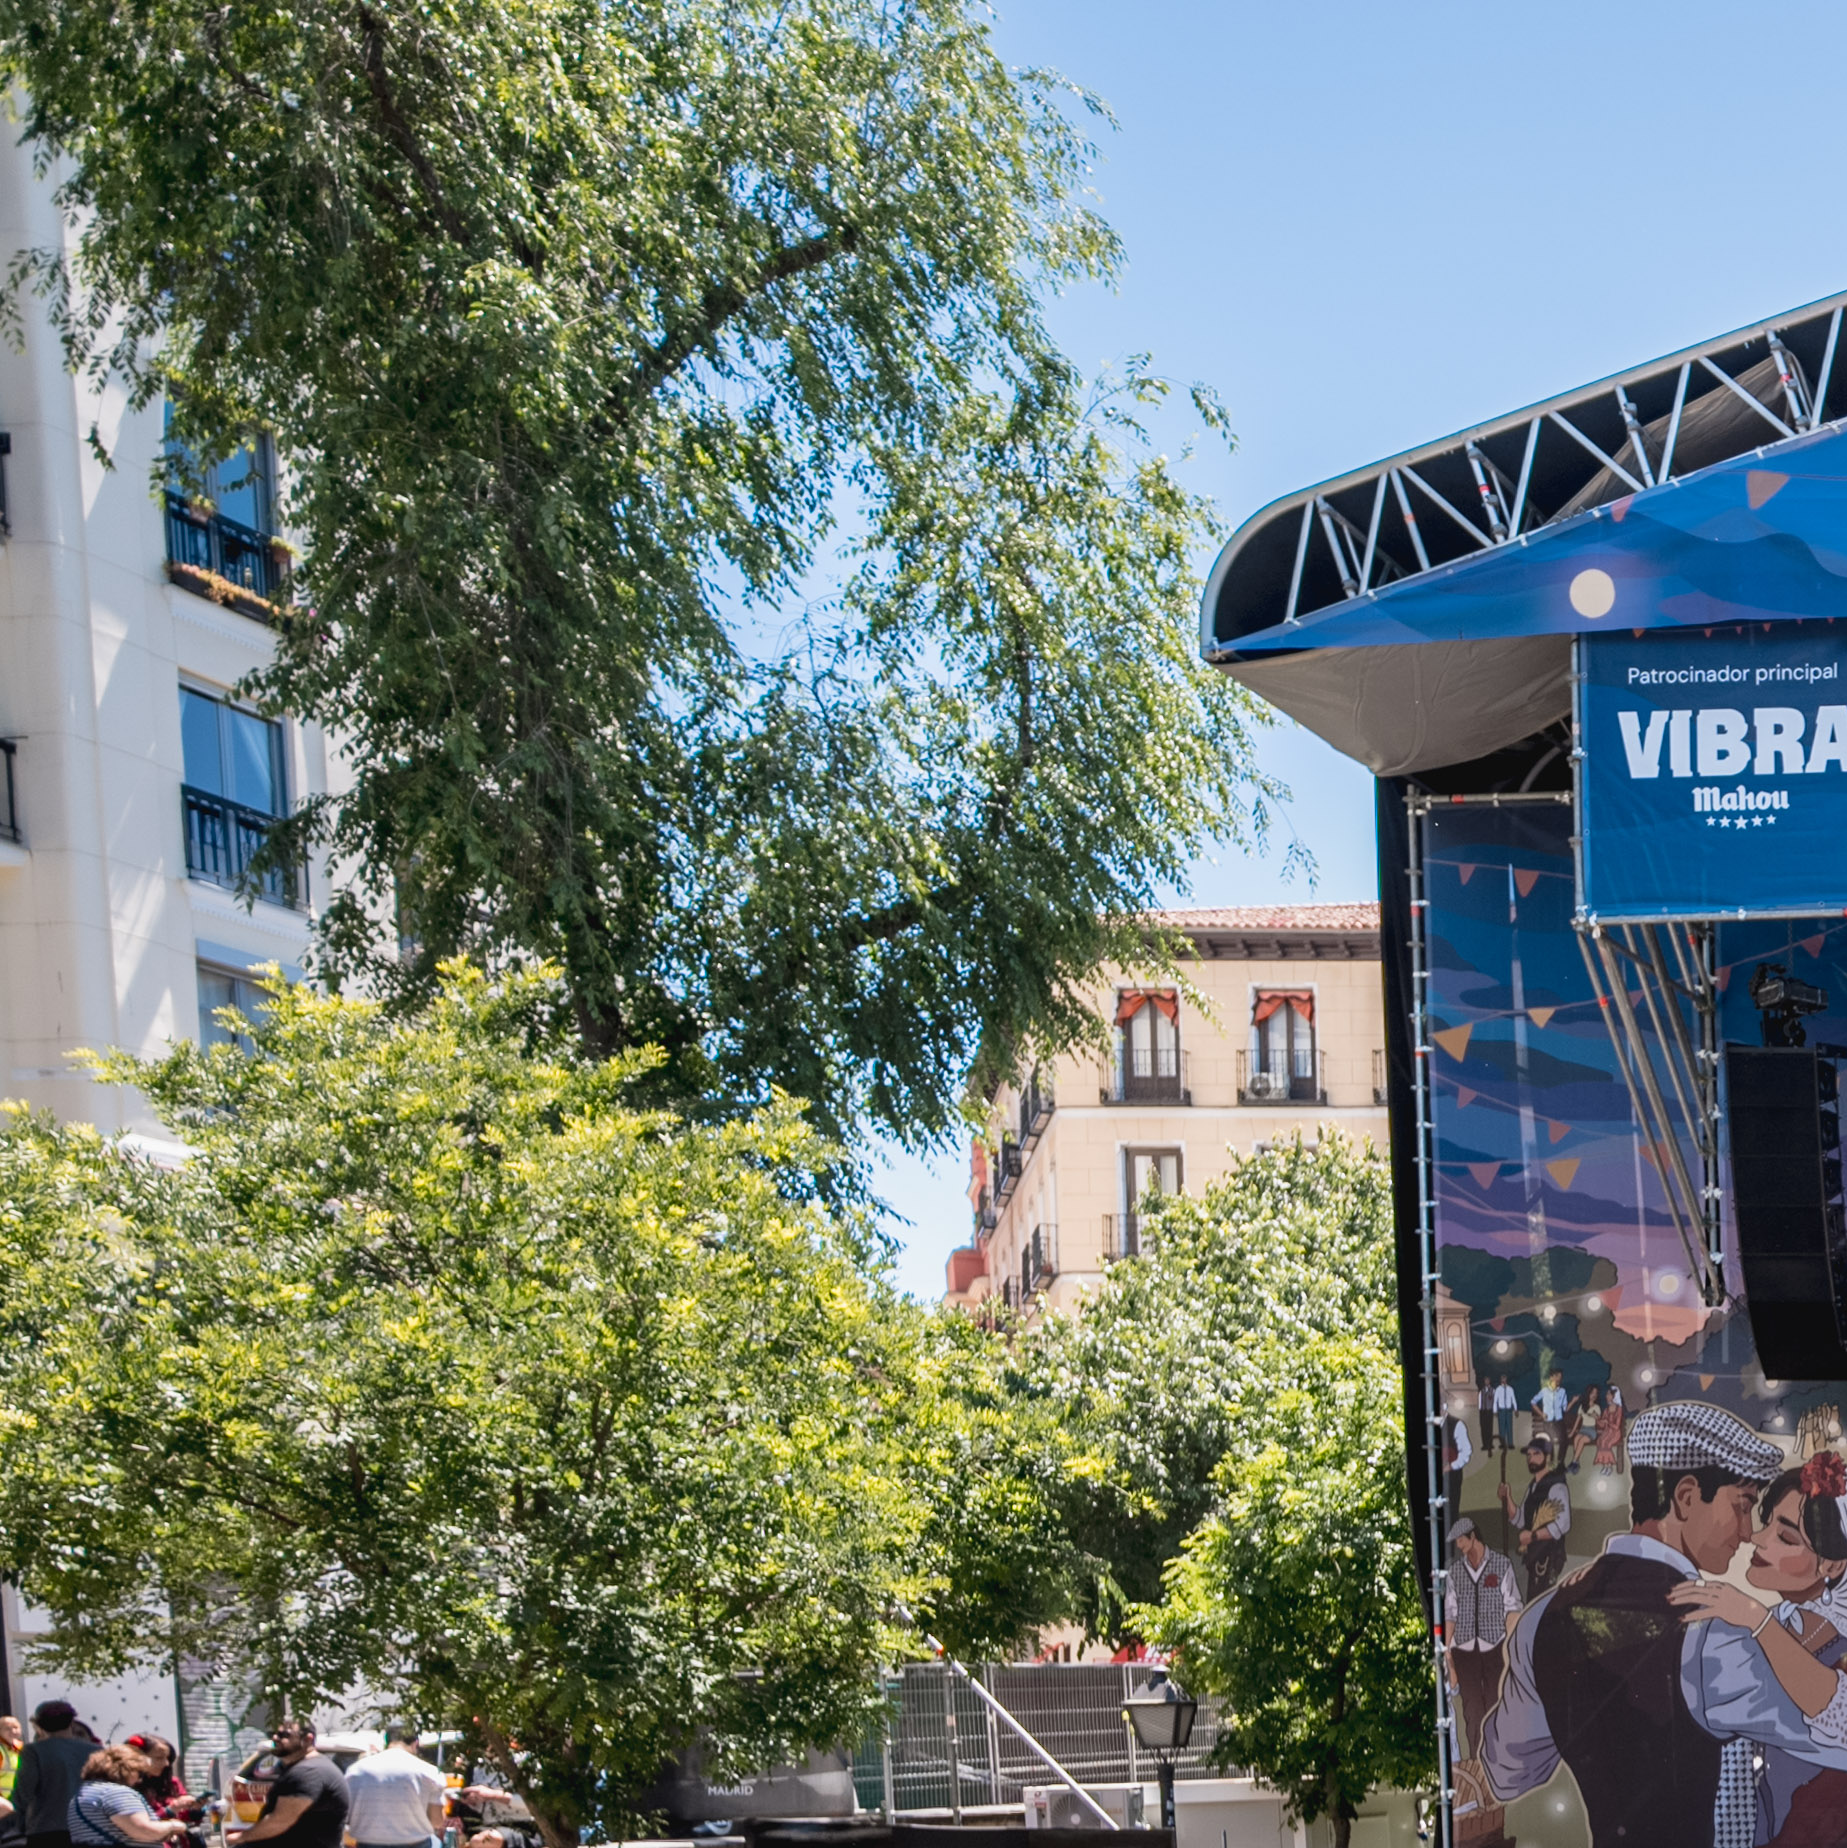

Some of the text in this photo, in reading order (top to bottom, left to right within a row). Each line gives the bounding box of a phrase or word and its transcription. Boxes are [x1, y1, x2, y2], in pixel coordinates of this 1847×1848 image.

[1628, 662, 1837, 686] Patrocinador principal
[1692, 785, 1790, 812] Mahou
[707, 1786, 754, 1796] MADRID
